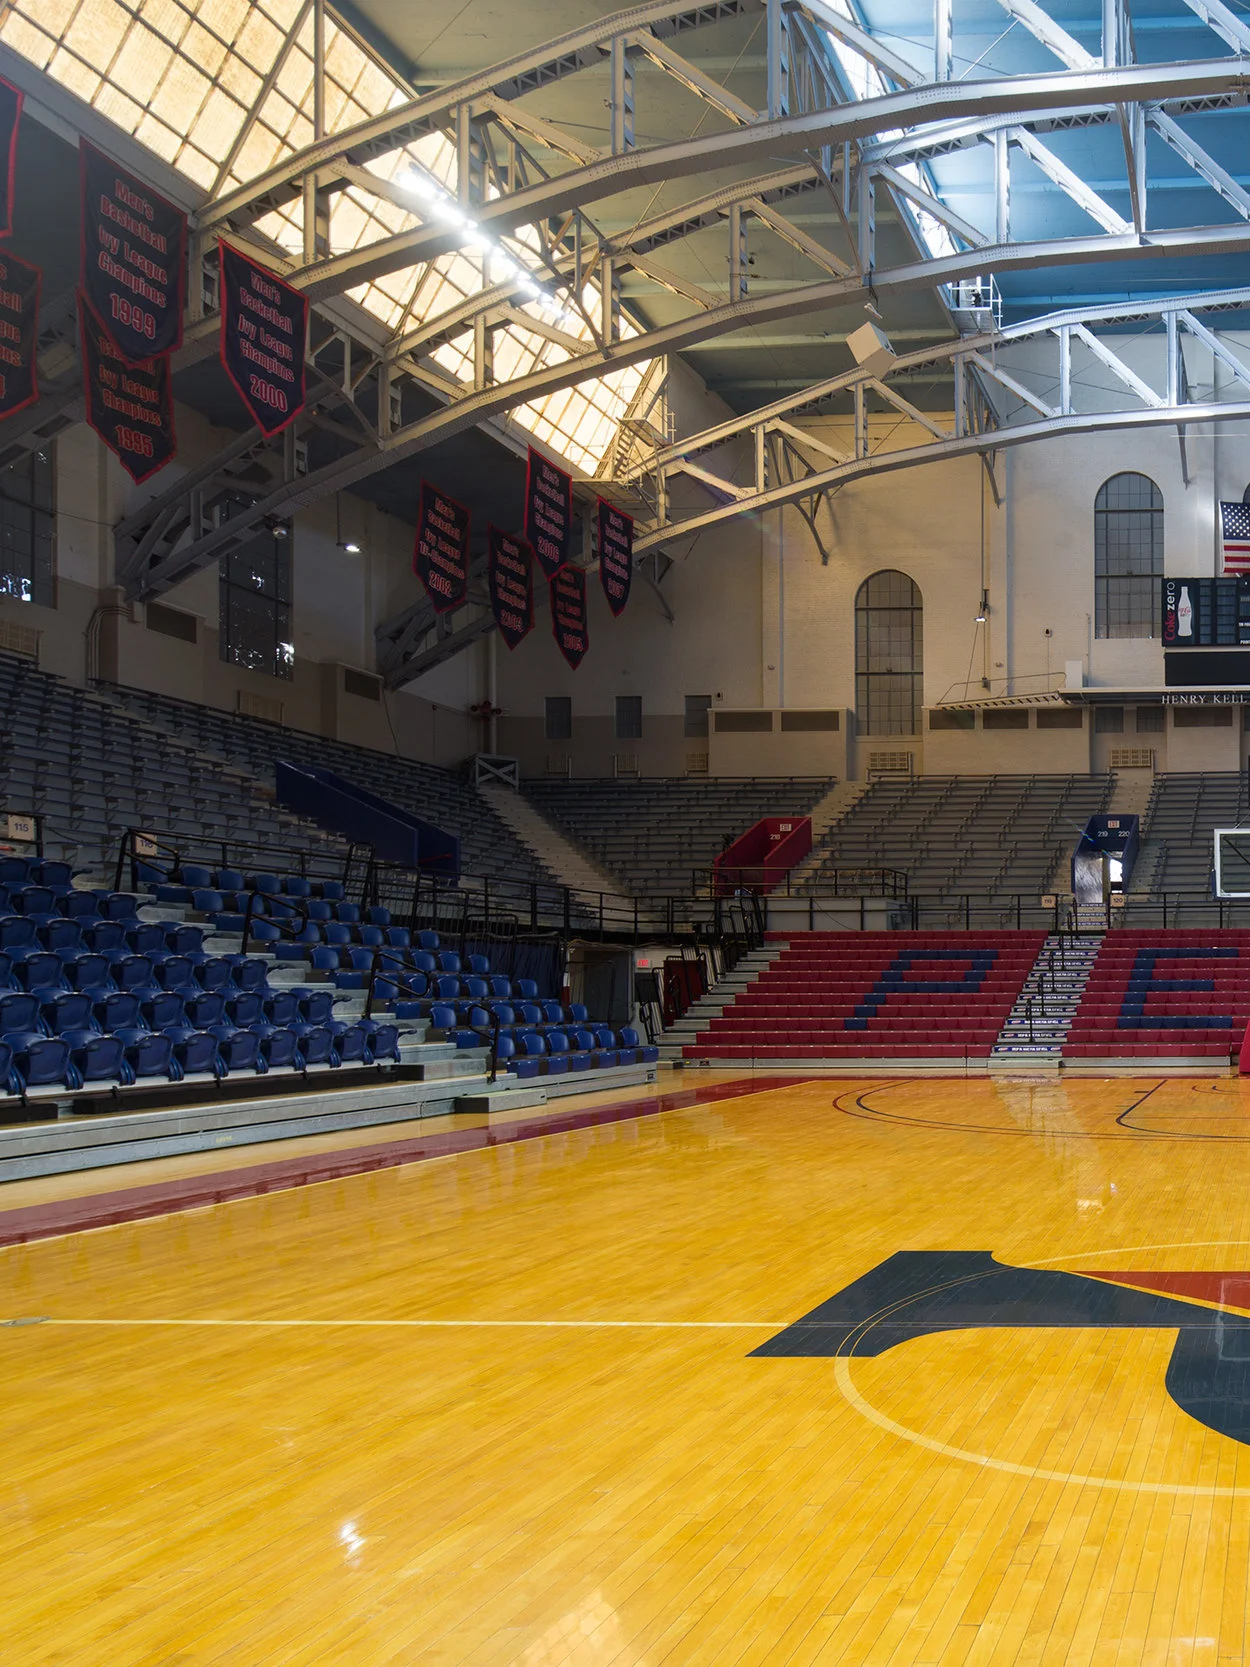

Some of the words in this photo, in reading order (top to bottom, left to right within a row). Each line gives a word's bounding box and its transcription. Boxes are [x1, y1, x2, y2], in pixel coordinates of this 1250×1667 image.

[115, 178, 154, 221] Men's
[101, 194, 167, 255] Basketball
[98, 224, 120, 255] Ivy
[124, 241, 168, 285] League
[98, 250, 166, 308] Champions
[250, 271, 281, 305] Men's
[110, 292, 156, 340] 1999
[239, 286, 293, 335] Basketball
[237, 313, 257, 340] Ivy
[259, 327, 293, 361] League
[239, 337, 295, 383] Champions
[98, 364, 118, 388] Ivy
[121, 374, 160, 404] League
[250, 373, 288, 413] 2000
[102, 388, 161, 427] Champions
[115, 424, 153, 458] 1995
[537, 535, 559, 563] 2006
[428, 570, 452, 599] 2002
[1167, 582, 1175, 611] zero
[1163, 611, 1176, 641] Coke
[1161, 694, 1206, 705] HENRY
[1213, 694, 1248, 704] KELL
[14, 822, 29, 832] 115
